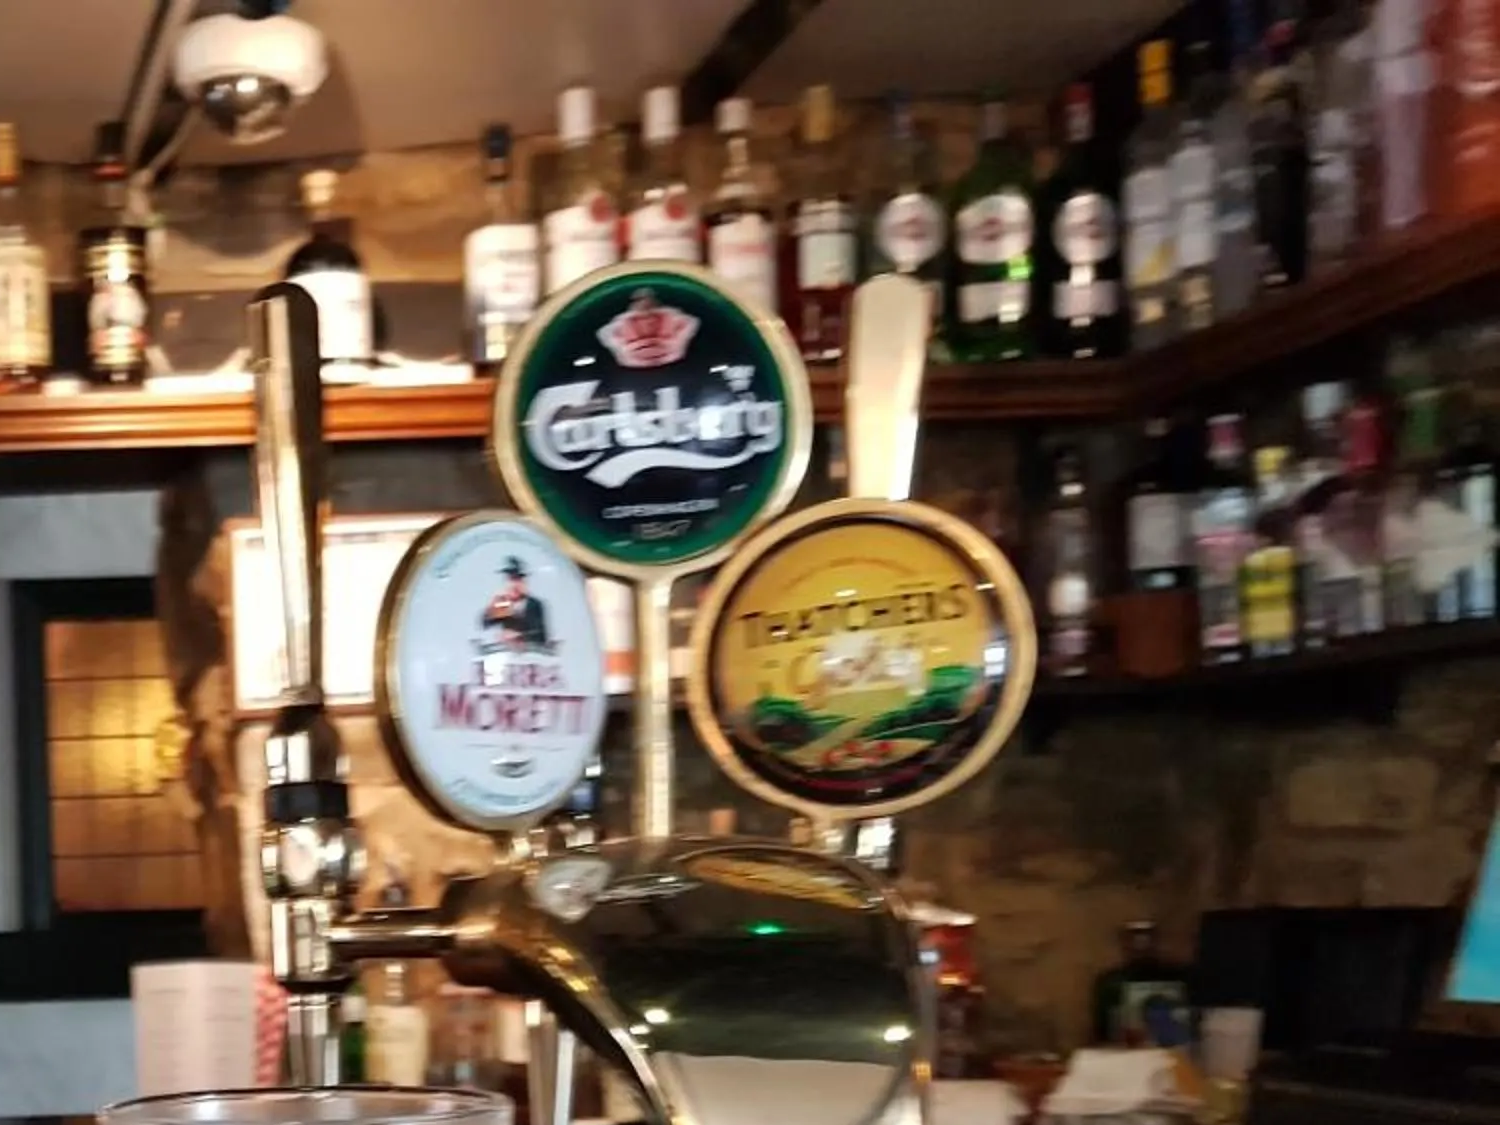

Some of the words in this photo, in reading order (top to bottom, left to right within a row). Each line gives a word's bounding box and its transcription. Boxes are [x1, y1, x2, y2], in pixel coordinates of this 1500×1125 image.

[523, 378, 784, 486] Carlsberg
[740, 585, 968, 649] THATCHERS
[473, 657, 565, 690] BRRA
[434, 683, 592, 734] MORETTI
